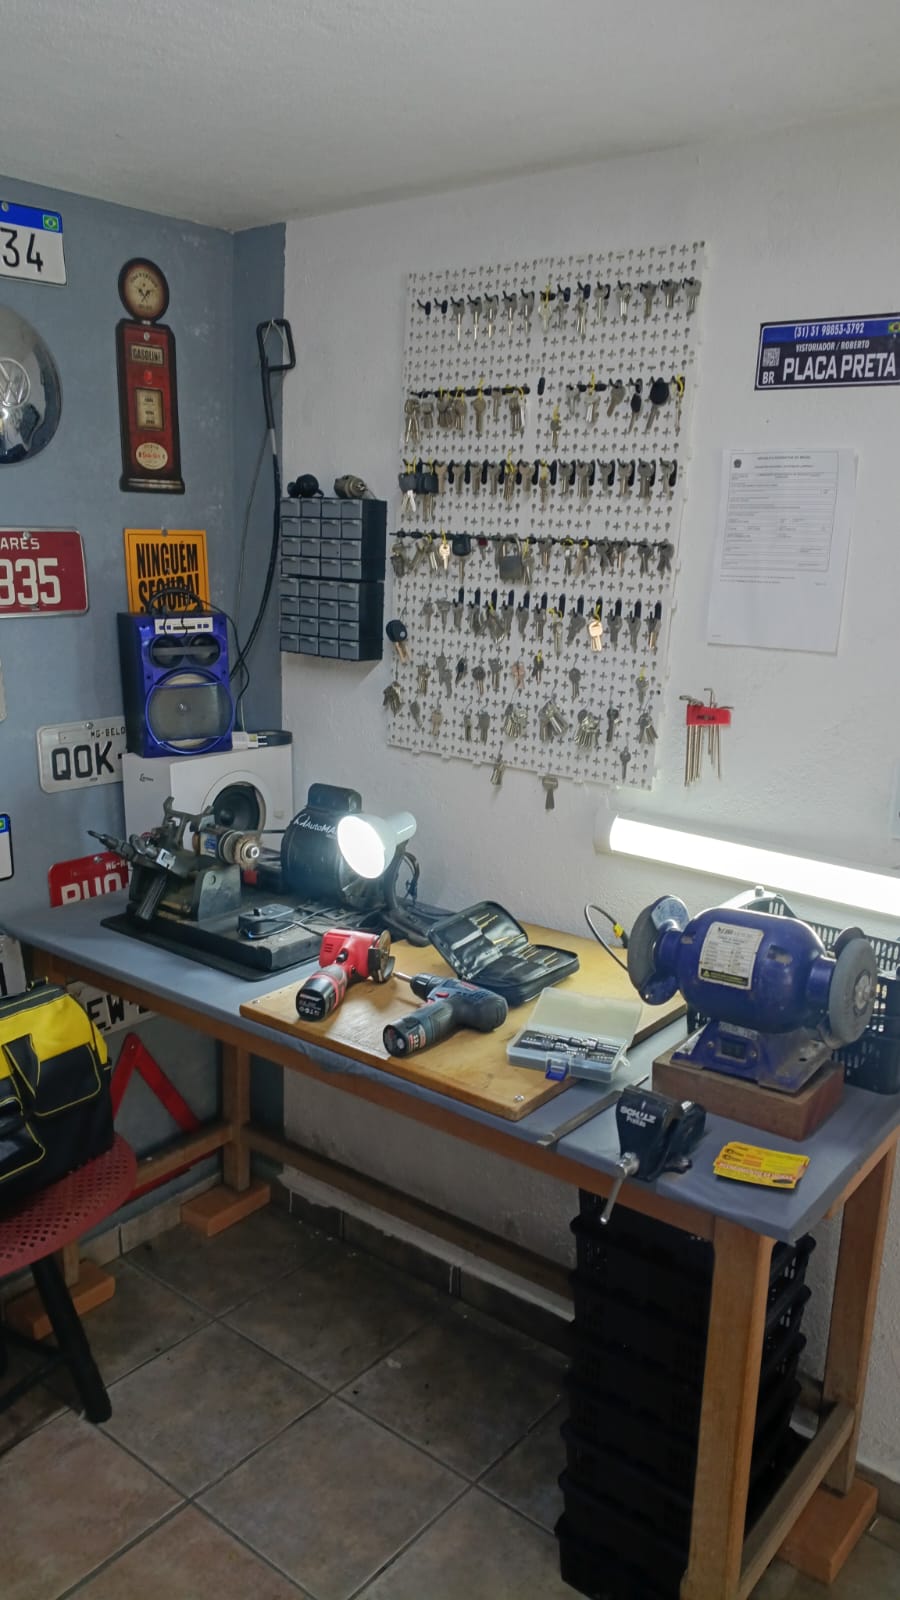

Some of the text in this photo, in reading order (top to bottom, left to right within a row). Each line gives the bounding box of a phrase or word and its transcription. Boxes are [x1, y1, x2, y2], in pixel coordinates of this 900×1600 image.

[0, 227, 43, 273] 34
[794, 326, 809, 339] (31)
[811, 326, 820, 337] 31
[762, 371, 775, 384] BR
[783, 352, 896, 381] PLACA PRETA
[136, 541, 199, 579] NINGUÉM
